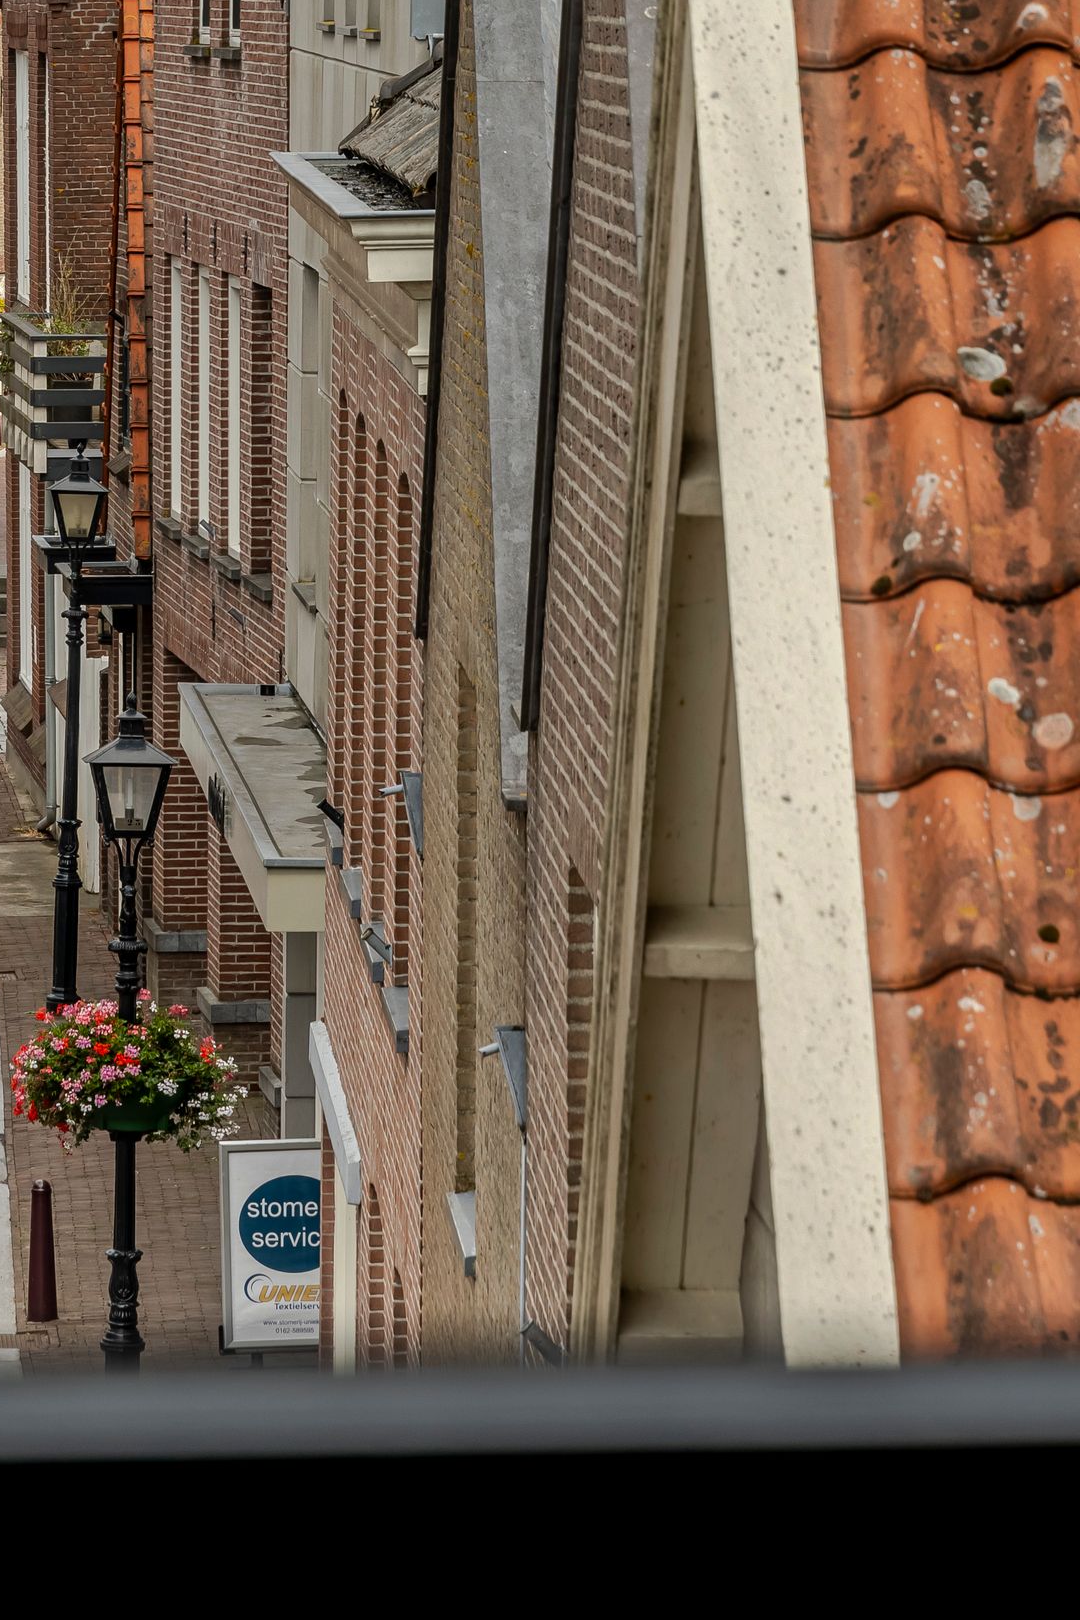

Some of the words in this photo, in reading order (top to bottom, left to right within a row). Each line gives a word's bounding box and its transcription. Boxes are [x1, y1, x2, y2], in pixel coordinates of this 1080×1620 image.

[247, 1197, 319, 1218] stome
[252, 1226, 321, 1248] servic
[258, 1284, 321, 1303] UNIE
